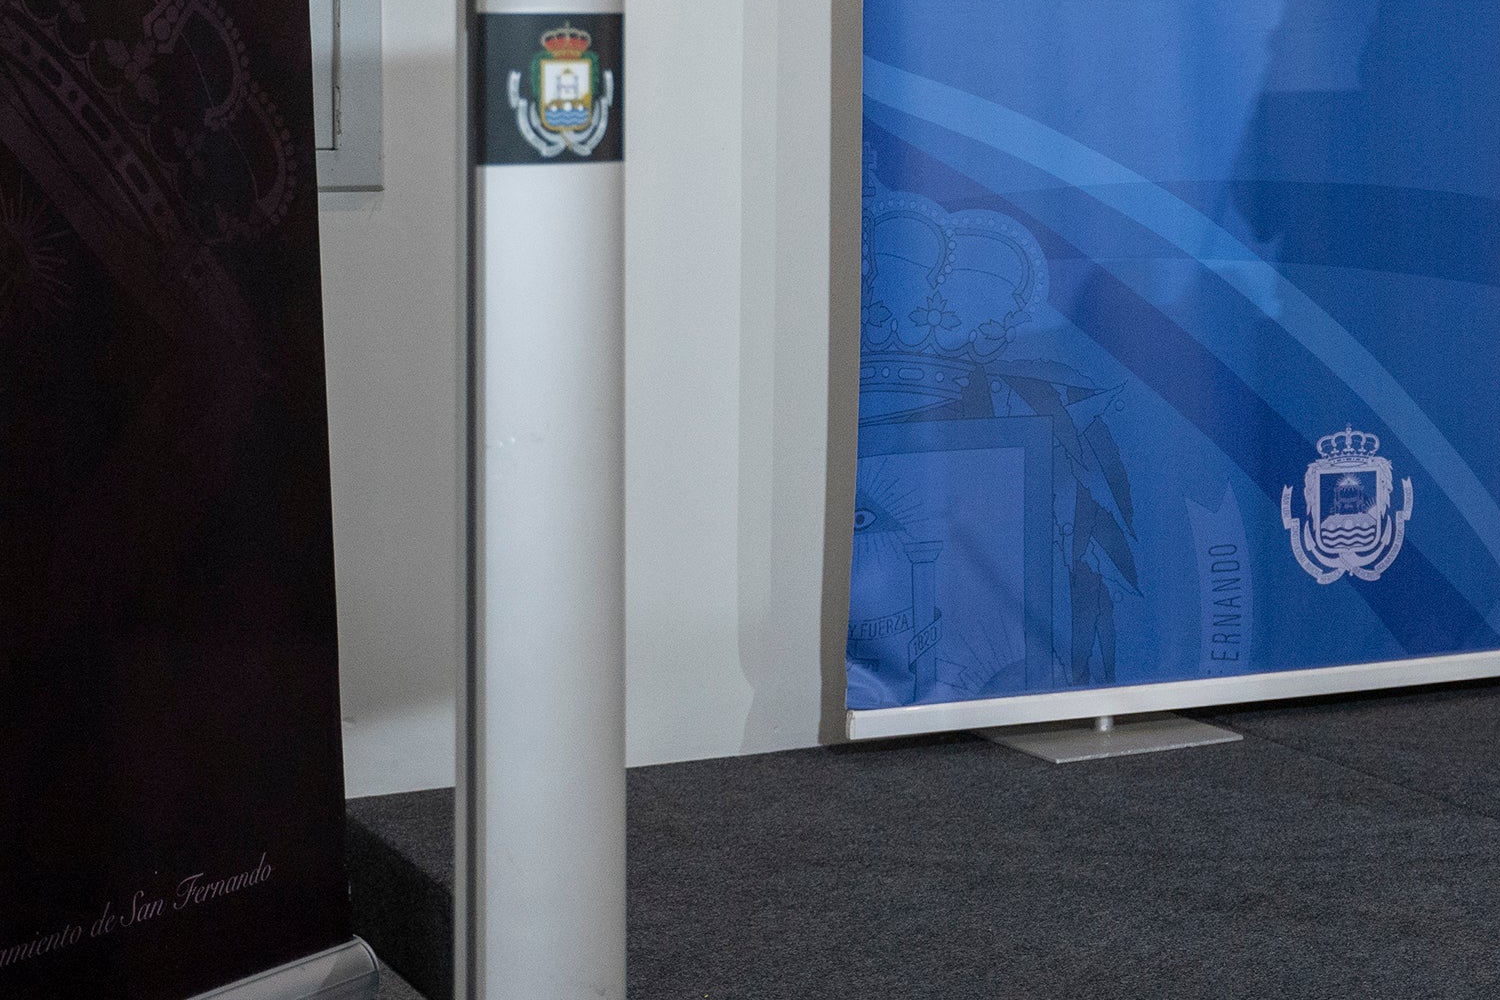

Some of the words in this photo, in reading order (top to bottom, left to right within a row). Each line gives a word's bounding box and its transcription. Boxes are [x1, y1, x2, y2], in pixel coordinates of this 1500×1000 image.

[860, 613, 909, 638] FUERZA
[1208, 543, 1242, 670] ERNANDO
[90, 901, 116, 938] de
[120, 889, 164, 927] San
[173, 852, 272, 910] Fernando
